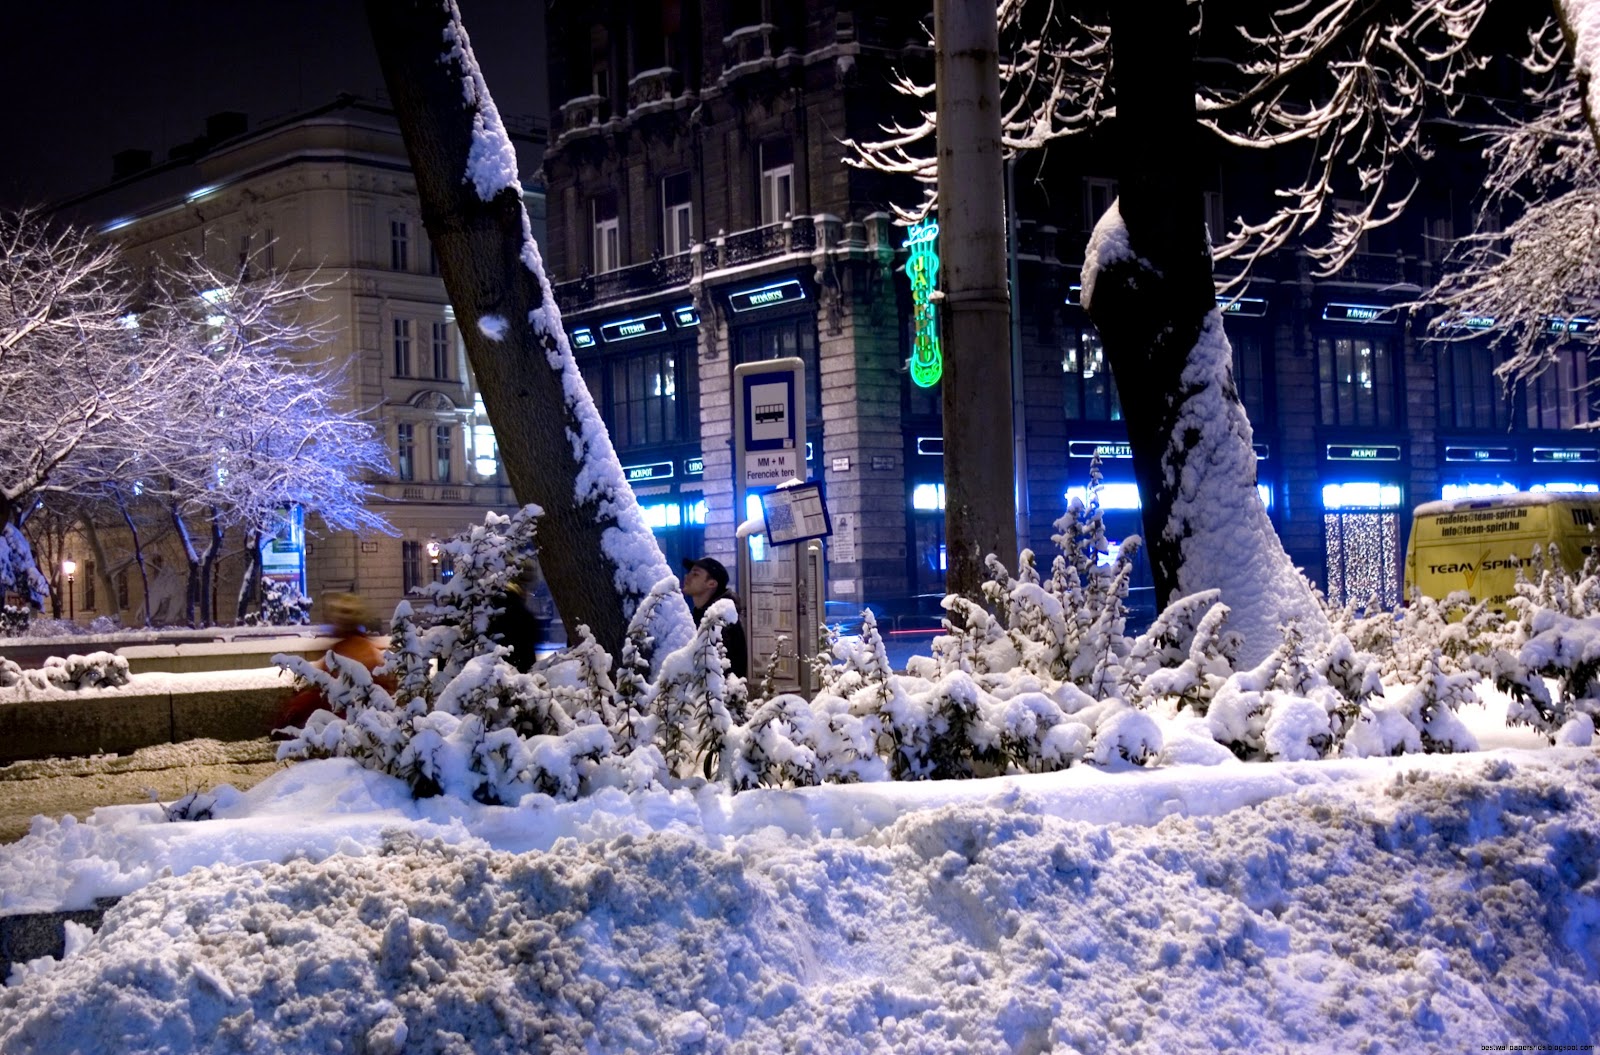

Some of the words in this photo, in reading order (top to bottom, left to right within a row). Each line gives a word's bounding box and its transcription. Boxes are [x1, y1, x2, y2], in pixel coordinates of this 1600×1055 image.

[1096, 445, 1132, 455] ROULETT
[1351, 449, 1378, 458] JACKPOT
[778, 456, 785, 466] M
[689, 462, 703, 472] LIDO
[630, 468, 653, 479] JACKPOT
[747, 469, 780, 480] Ferenciek
[781, 468, 795, 478] tere
[1436, 509, 1527, 525] rendeles@team-spirit.hu
[1442, 522, 1519, 536] info@team-spirit.hu
